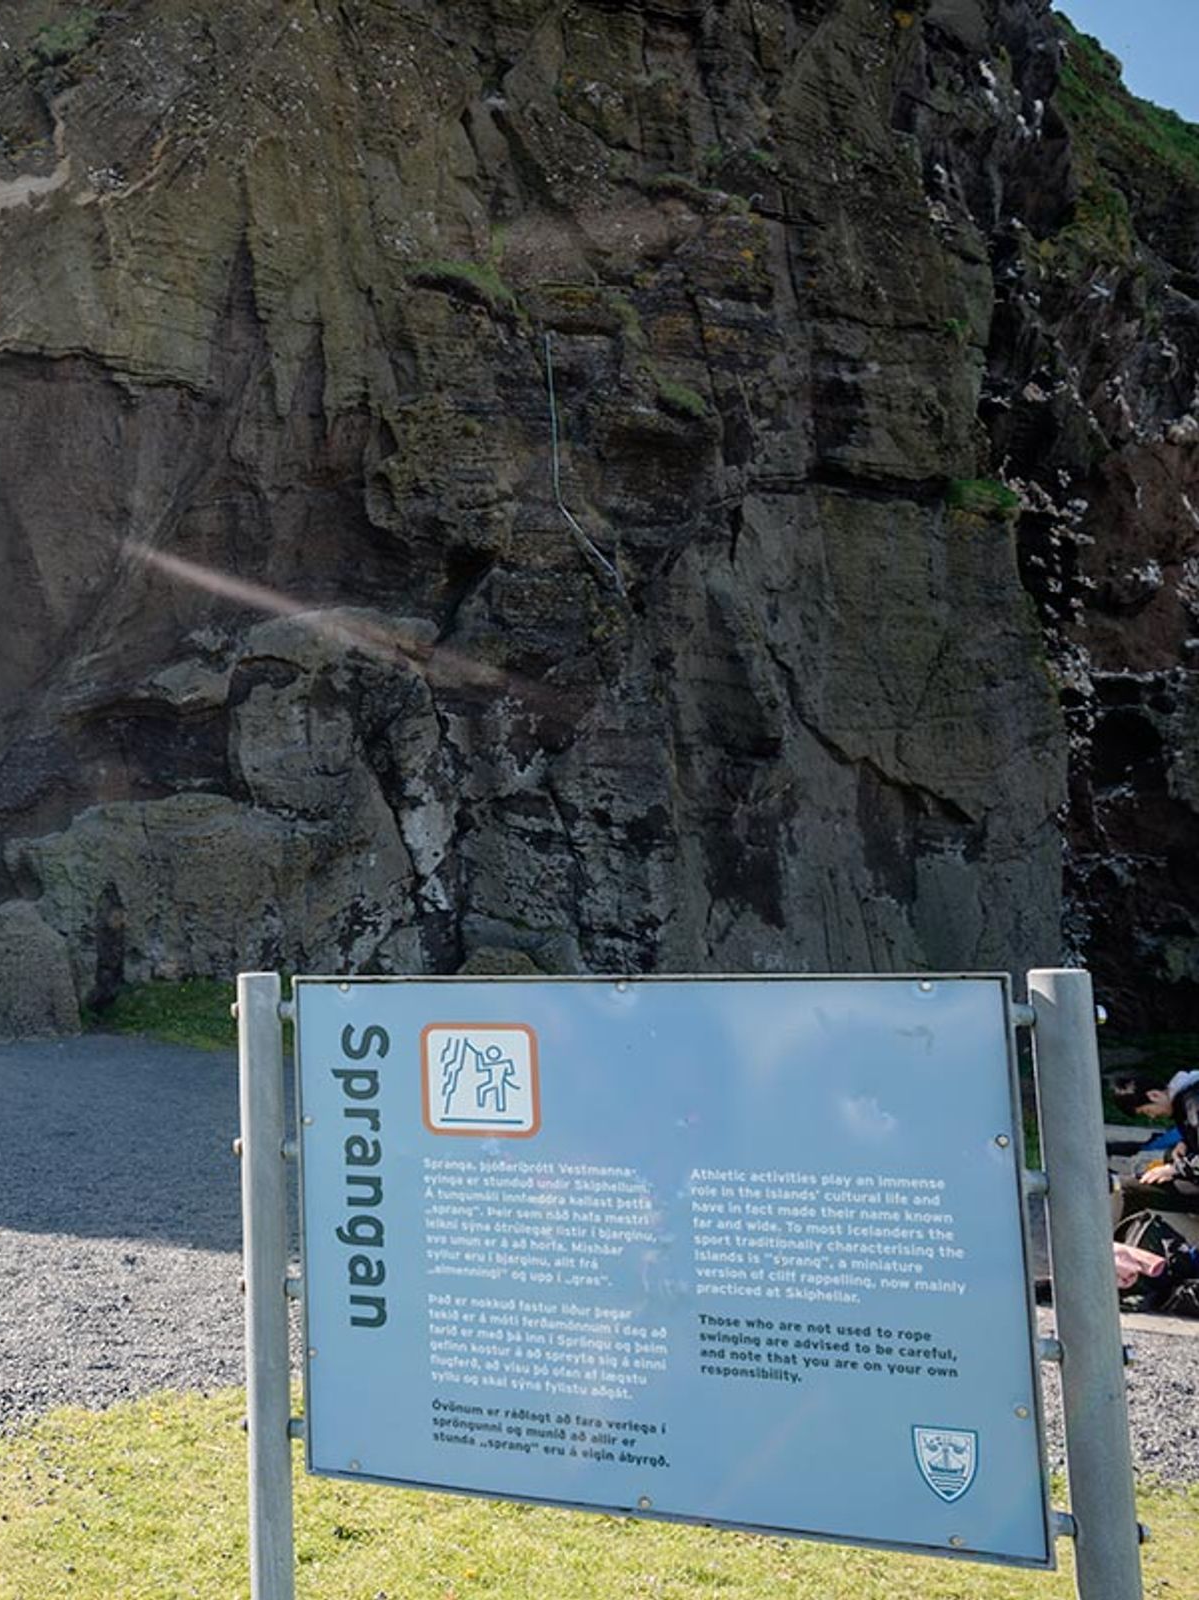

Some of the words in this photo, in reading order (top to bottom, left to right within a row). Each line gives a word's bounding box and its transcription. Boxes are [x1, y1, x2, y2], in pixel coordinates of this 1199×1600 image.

[331, 1024, 390, 1328] Sprangan
[691, 1170, 745, 1182] Athletic
[751, 1172, 817, 1185] activities
[821, 1175, 851, 1189] play
[856, 1178, 873, 1187] an
[878, 1177, 945, 1189] immense
[691, 1186, 716, 1197] role
[721, 1187, 734, 1198] in
[738, 1187, 761, 1199] the
[824, 1191, 881, 1204] cultural
[885, 1193, 907, 1205] life
[913, 1195, 940, 1206] and
[692, 1201, 724, 1213] have
[728, 1203, 741, 1214] in
[745, 1204, 773, 1215] fact
[778, 1206, 816, 1217] made
[821, 1207, 854, 1219] their
[860, 1211, 899, 1221] name
[904, 1211, 953, 1223] known
[693, 1217, 712, 1229] far
[716, 1219, 741, 1230] and
[786, 1222, 801, 1233] To
[806, 1224, 843, 1235] most
[929, 1229, 954, 1240] the
[694, 1235, 731, 1248] sport
[735, 1236, 822, 1254] traditionally
[827, 1241, 934, 1260] characterising
[939, 1247, 964, 1258] the
[748, 1253, 759, 1264] is
[838, 1260, 847, 1269] a
[851, 1259, 923, 1273] miniature
[696, 1268, 746, 1280] version
[750, 1270, 764, 1281] of
[768, 1271, 796, 1282] cliff
[881, 1279, 909, 1289] now
[915, 1279, 966, 1295] mainly
[697, 1285, 761, 1297] practiced
[766, 1288, 780, 1298] at
[699, 1314, 740, 1327] Those
[746, 1318, 773, 1329] who
[779, 1322, 801, 1331] are
[807, 1323, 831, 1334] not
[837, 1326, 871, 1336] used
[877, 1327, 892, 1338] to
[897, 1331, 931, 1343] rope
[700, 1332, 760, 1349] swinging
[766, 1338, 788, 1348] are
[793, 1339, 849, 1352] advised
[856, 1343, 871, 1354] to
[875, 1344, 892, 1355] be
[898, 1348, 957, 1361] careful,
[701, 1349, 725, 1359] and
[730, 1351, 761, 1362] note
[767, 1352, 797, 1365] that
[803, 1357, 829, 1369] you
[835, 1360, 859, 1369] are
[863, 1362, 881, 1371] on
[887, 1364, 920, 1375] your
[927, 1367, 958, 1377] own
[701, 1364, 801, 1383] responsibility.
